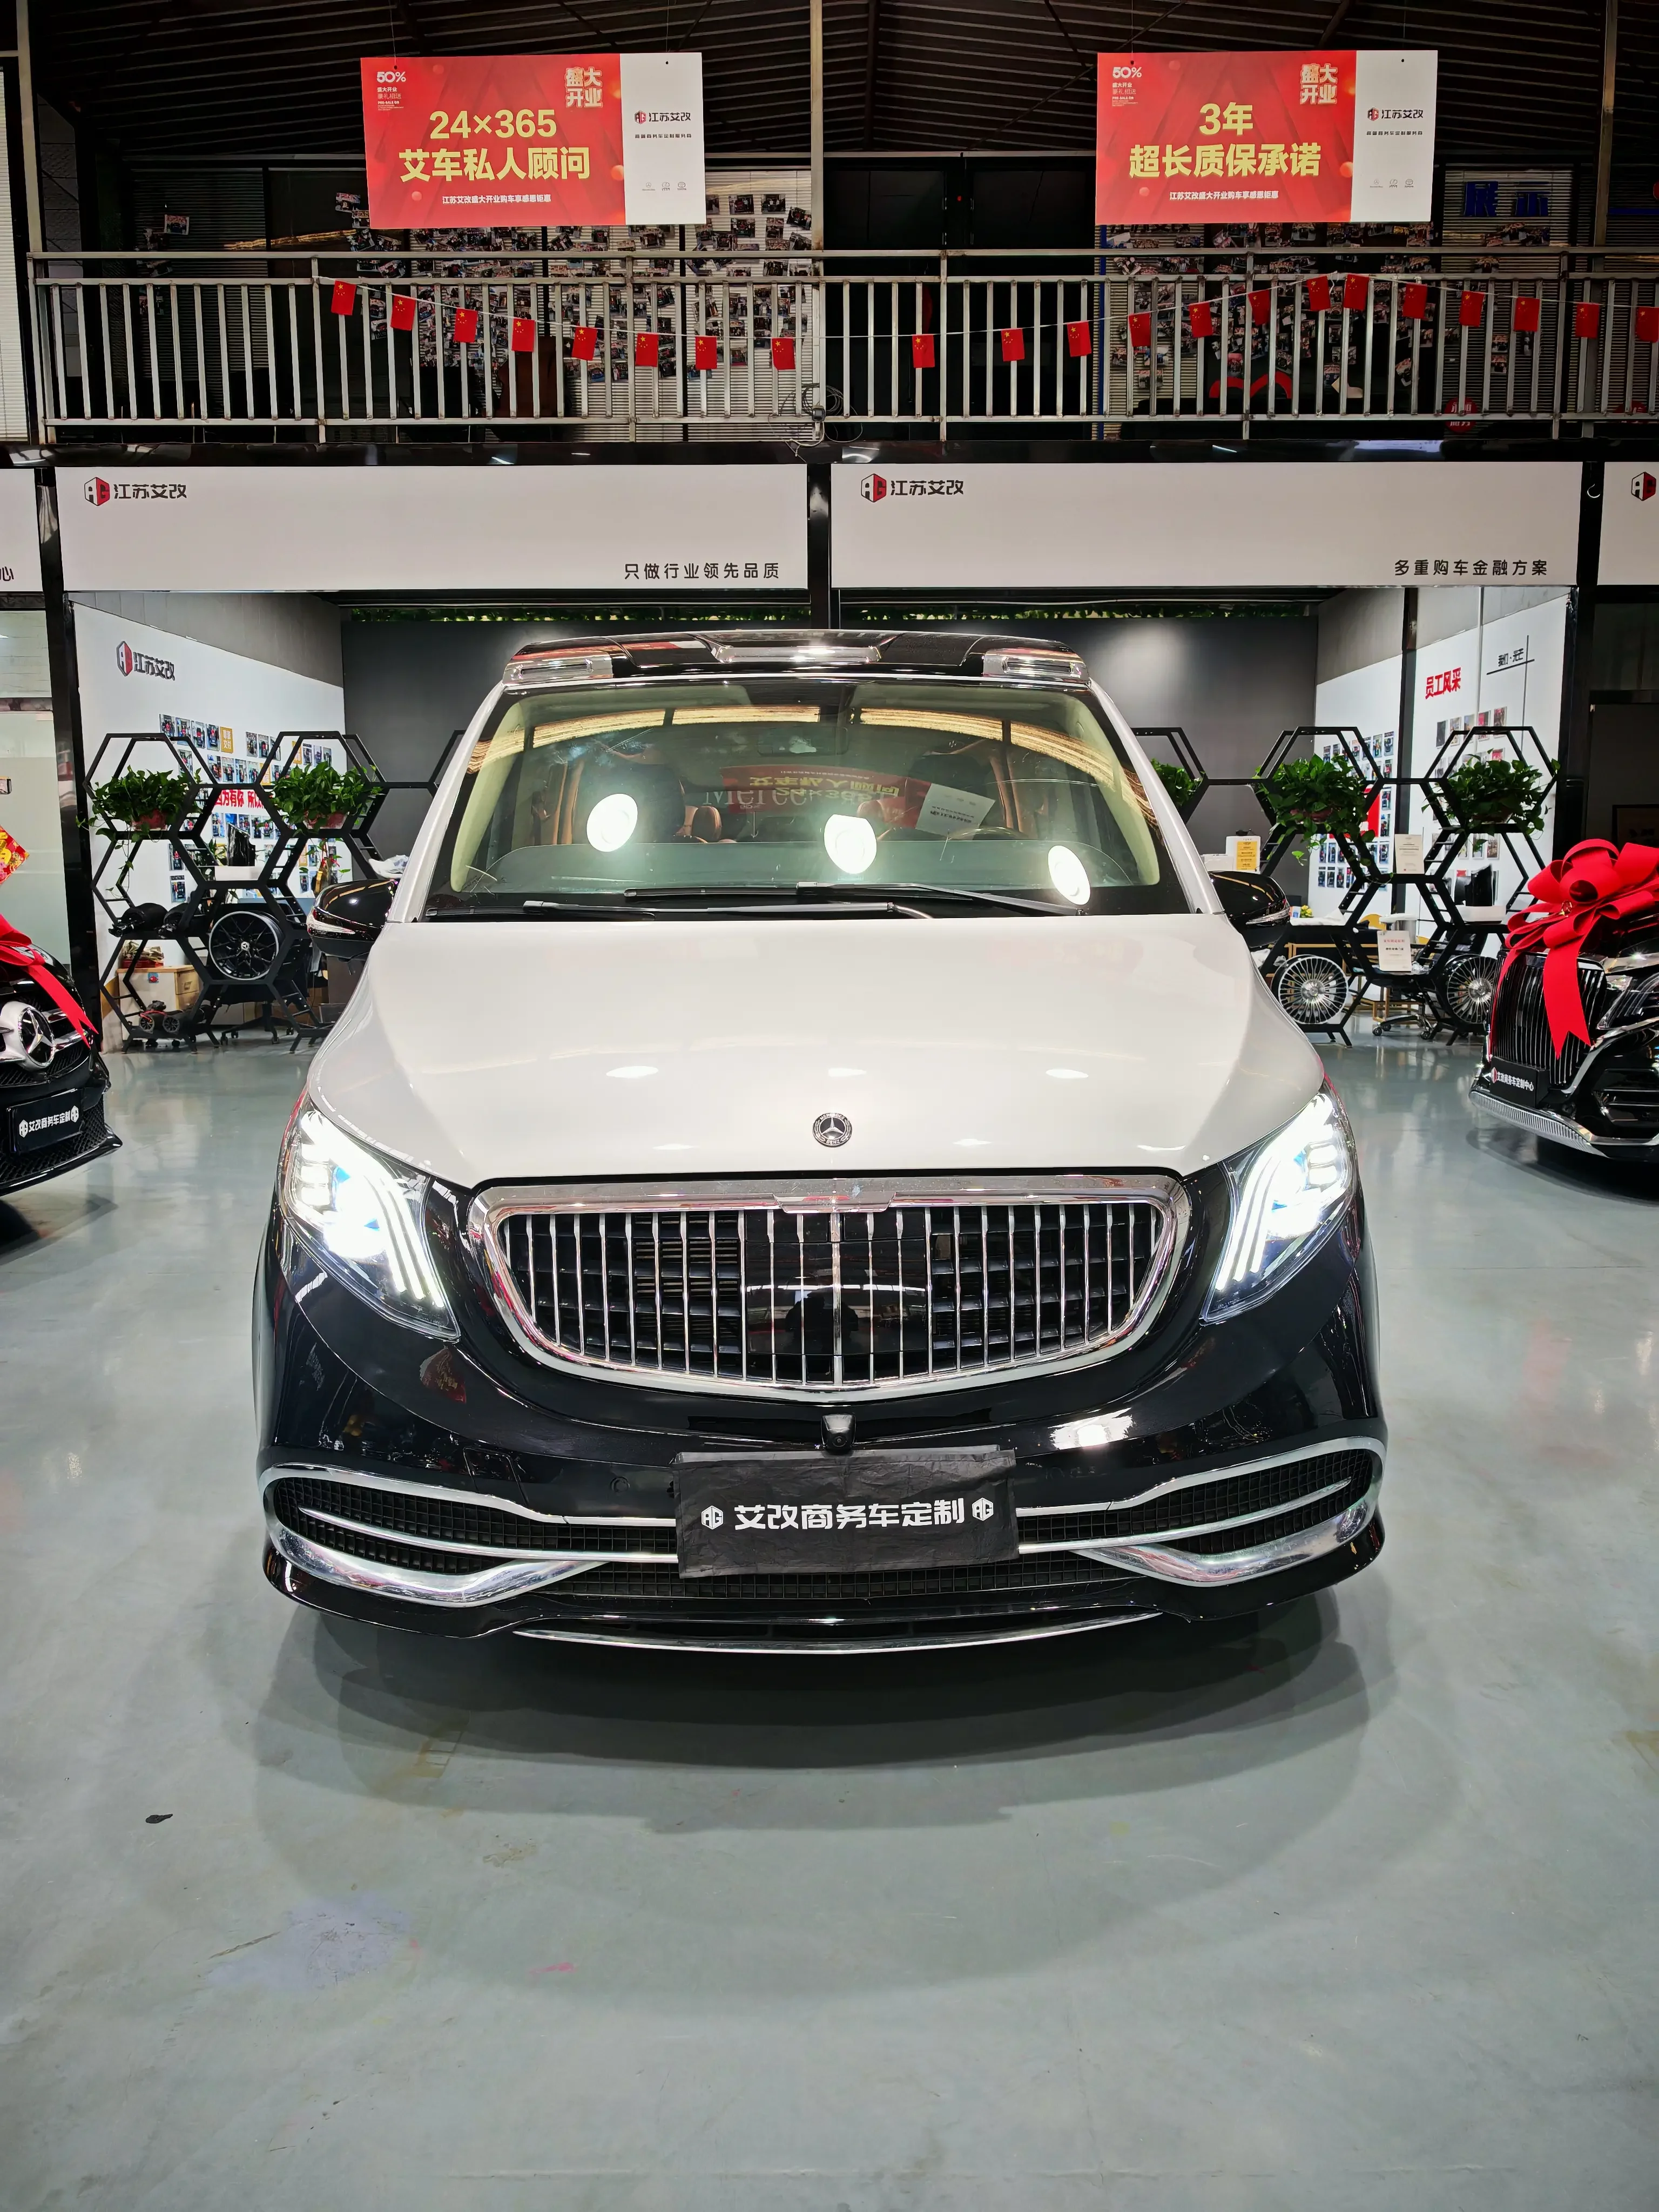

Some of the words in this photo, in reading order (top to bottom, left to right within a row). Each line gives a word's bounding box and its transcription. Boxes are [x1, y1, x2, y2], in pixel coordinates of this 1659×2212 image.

[377, 71, 407, 83] 50%
[565, 67, 603, 87] 盛大
[1112, 66, 1142, 78] 50%
[1301, 63, 1337, 84] 盛大
[565, 87, 603, 107] 开业
[1300, 84, 1337, 104] 开业
[649, 112, 691, 122] 江苏艾改
[1199, 102, 1253, 135] 3年
[1381, 109, 1424, 119] 江苏艾改
[399, 146, 591, 183] 艾车私人顾问
[1129, 143, 1321, 178] 超长质保承诺
[113, 484, 187, 499] 江苏艾改
[891, 480, 964, 496] 江苏艾改
[624, 562, 779, 580] 只做行业领先品质
[1394, 559, 1547, 576] 多重购车金融方案
[133, 651, 175, 681] 江苏艾改
[1425, 667, 1461, 699] 员工风采
[29, 1110, 71, 1132] 艾改商务车定制
[734, 1498, 965, 1530] 艾改商务车定制
